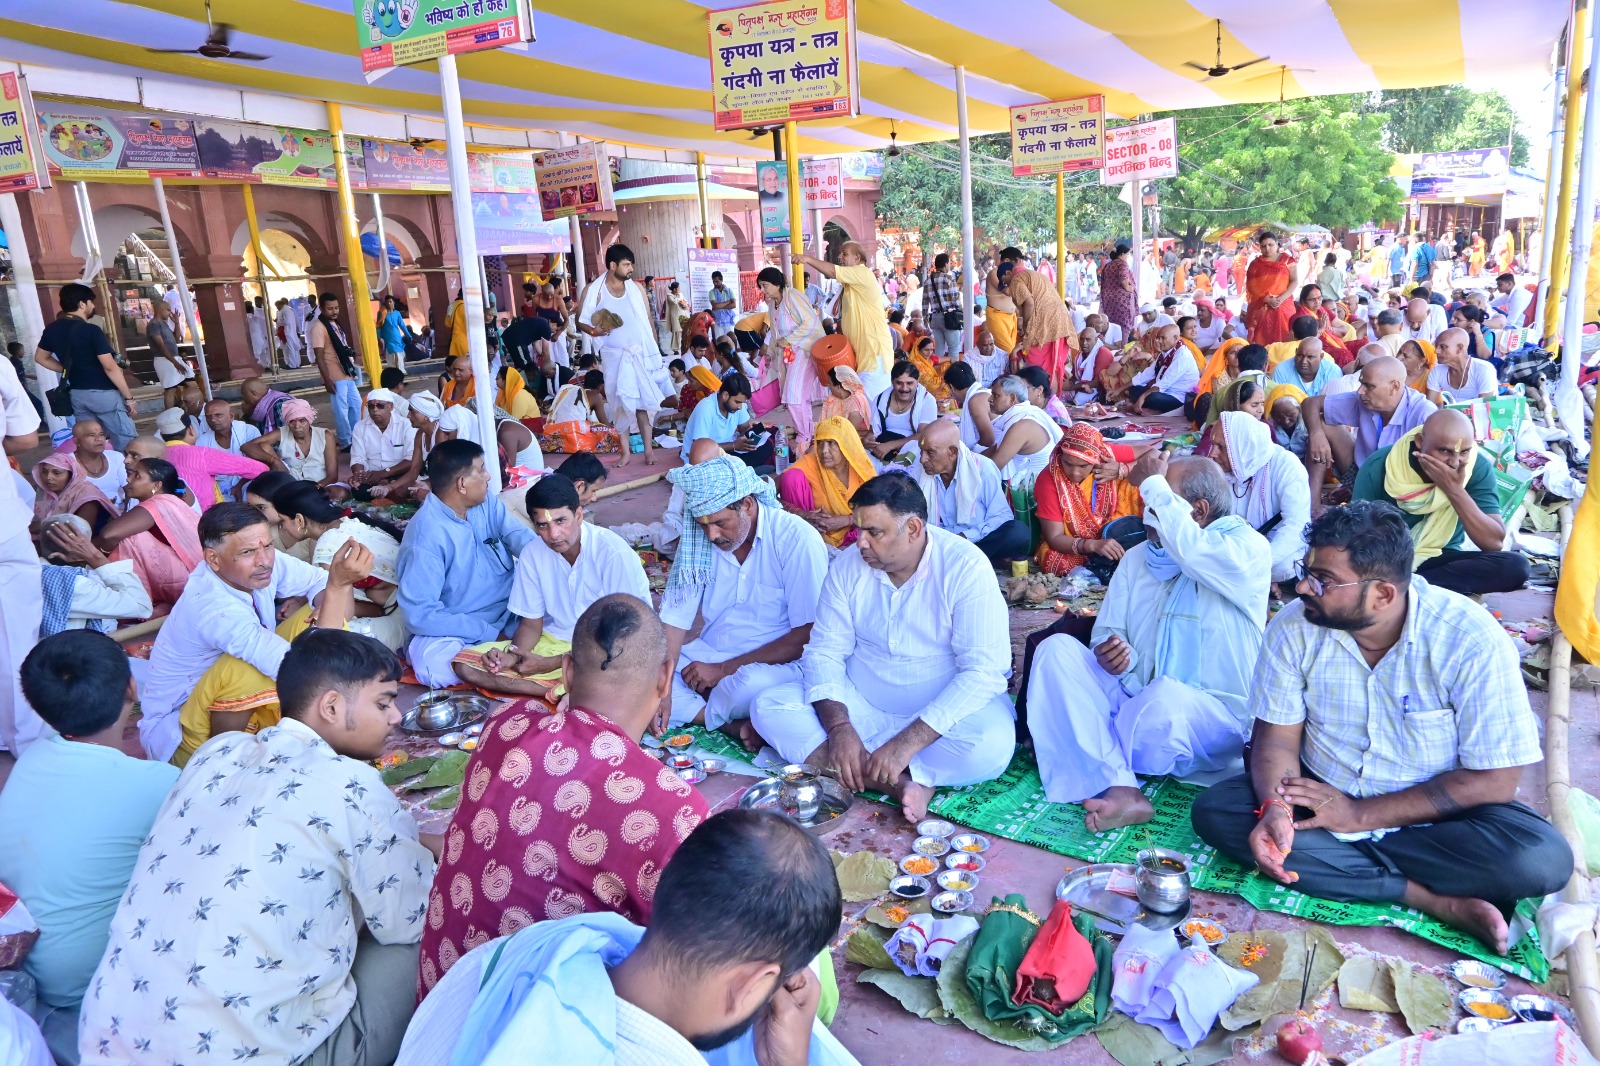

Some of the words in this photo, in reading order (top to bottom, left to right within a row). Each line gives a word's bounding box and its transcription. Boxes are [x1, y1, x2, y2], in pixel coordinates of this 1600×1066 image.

[425, 7, 454, 25] भविष्य
[501, 26, 513, 38] 76
[719, 42, 763, 67] कृपया
[768, 37, 795, 55] यत्र
[811, 30, 838, 49] तत्र
[721, 67, 762, 90] गंदगी
[767, 69, 785, 84] ना
[790, 57, 839, 81] फैलायें
[0, 111, 18, 127] तत्र
[1017, 125, 1047, 140] कृपया
[1050, 122, 1068, 133] यत्र
[1079, 119, 1097, 129] तत्र
[0, 135, 24, 157] लायें
[1018, 140, 1046, 154] गंदगी
[1049, 141, 1062, 150] ना
[1064, 134, 1097, 149] फैलायें
[1107, 143, 1147, 160] SECTOR
[1159, 138, 1172, 151] 08
[1108, 161, 1146, 176] प्रारंभिक
[1149, 156, 1172, 169] बिन्दु
[804, 177, 819, 188] TOR
[827, 176, 838, 186] 08
[1312, 902, 1354, 919] Sprite
